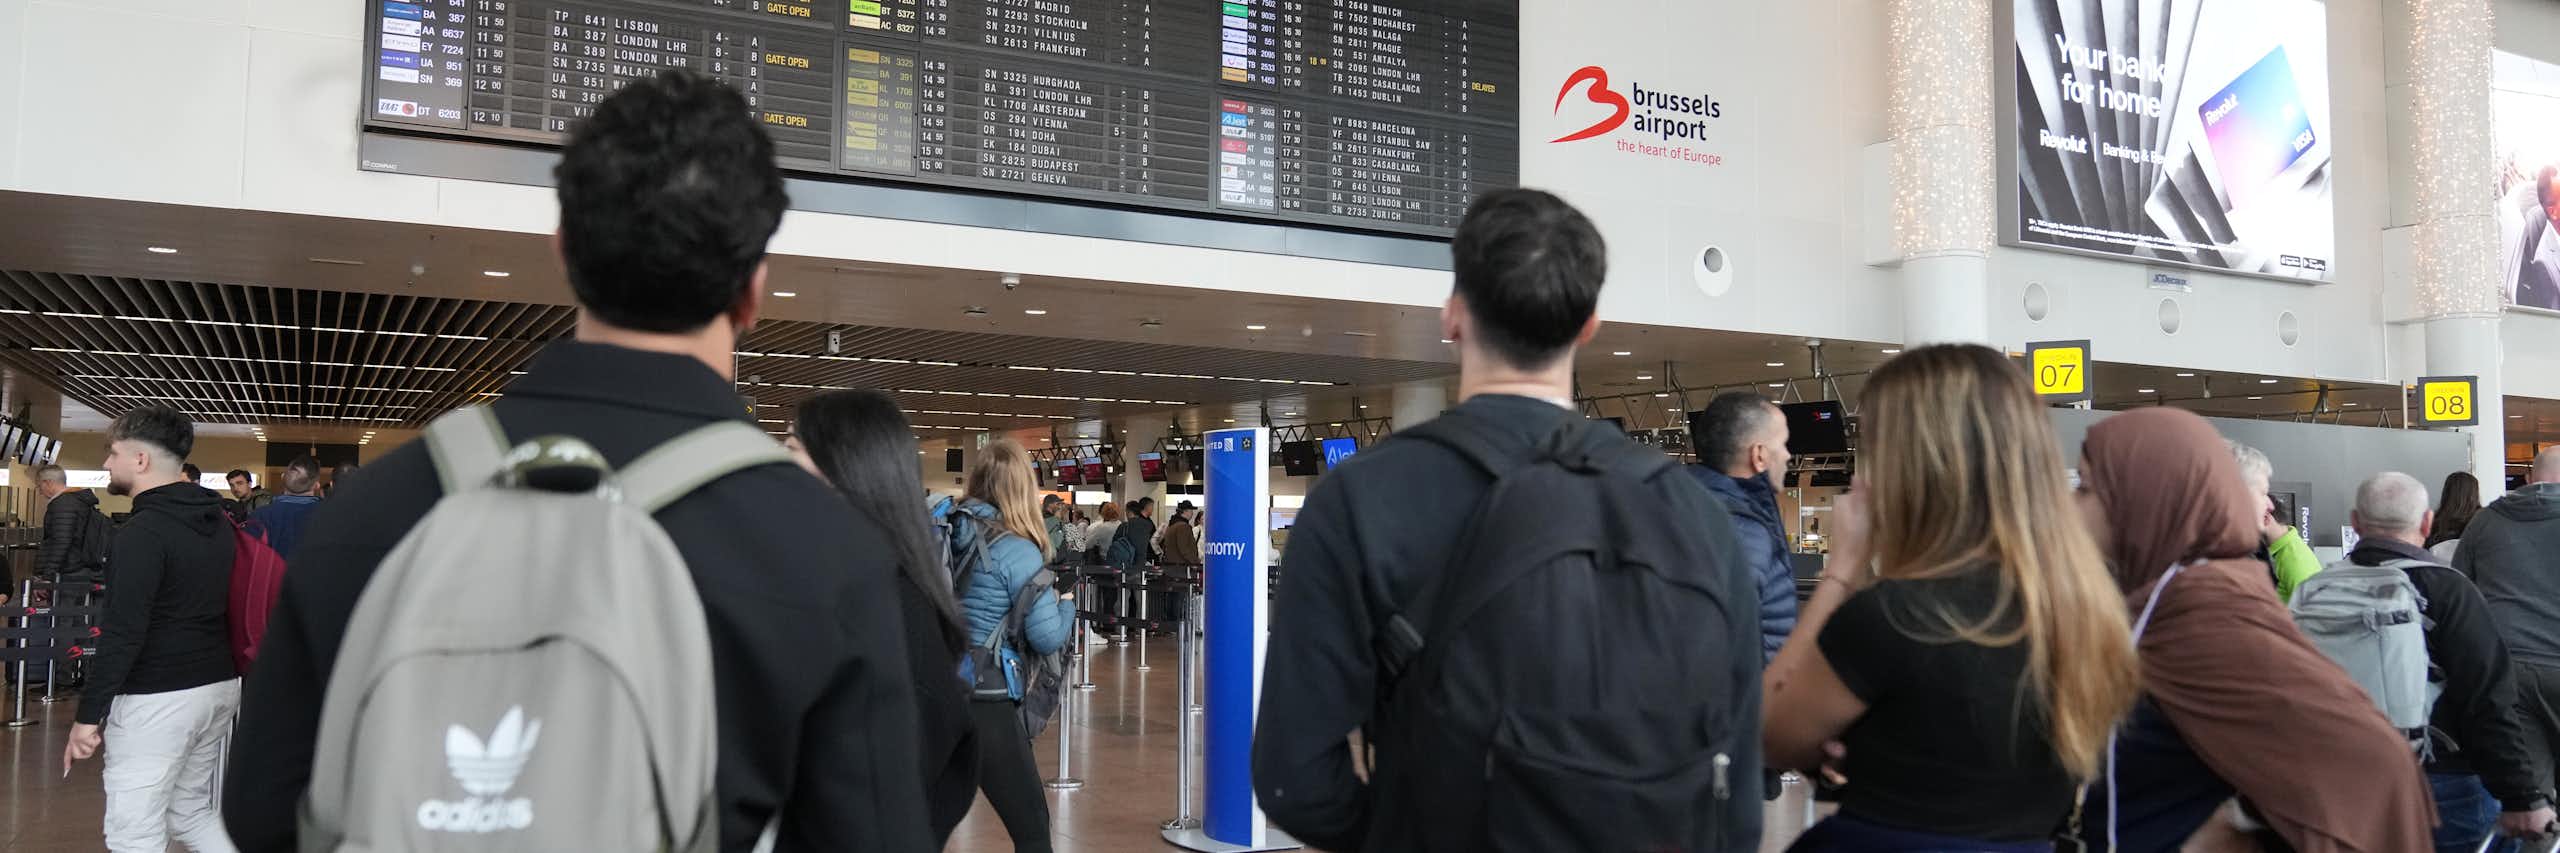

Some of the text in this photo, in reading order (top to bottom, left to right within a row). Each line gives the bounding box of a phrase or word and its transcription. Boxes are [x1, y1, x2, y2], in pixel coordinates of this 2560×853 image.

[423, 10, 435, 19] BA
[768, 3, 810, 18] GATE OPEN
[1034, 1, 1070, 14] MADRID
[1373, 6, 1402, 18] MUNICH
[479, 1, 658, 34] 11 50 TP 641 LISBON
[1034, 15, 1087, 30] STOCKHOLM
[1373, 17, 1416, 32] BUCHAREST
[422, 26, 464, 39] AA 6637
[1034, 28, 1075, 42] VILNIUS
[1373, 30, 1401, 41] MALAGA
[422, 42, 433, 51] EY
[478, 16, 808, 68] 11 50 BA 387 LONDON LHR GATE OPEN
[1034, 42, 1087, 57] FRANKFURT
[1373, 42, 1401, 54] PRAGUE
[478, 32, 686, 68] 11 50 BA 389 LONDON LHR
[421, 59, 433, 68] UA
[478, 48, 487, 57] 11
[494, 49, 503, 58] 50
[553, 58, 567, 68] SN
[576, 60, 605, 73] 3735
[1373, 54, 1406, 67] ANTALYA
[2055, 33, 2165, 83] Your bank
[477, 64, 486, 73] 11
[494, 65, 502, 74] 55
[553, 74, 567, 84] UA
[584, 77, 604, 88] 951
[1373, 67, 1401, 78] LONDON
[1407, 72, 1420, 81] LHR
[1033, 76, 1081, 91] HURGHADA
[1373, 79, 1420, 94] CASABLANCA
[1033, 90, 1069, 102] LONDON
[1075, 94, 1092, 105] LHR
[1372, 91, 1401, 103] DUBLIN
[1633, 82, 1720, 118] brussels
[2062, 73, 2160, 117] for home
[475, 80, 487, 89] 12
[492, 81, 502, 89] 00
[552, 89, 566, 99] SN
[764, 113, 783, 124] GATE
[786, 116, 807, 127] OPEN
[1033, 104, 1086, 119] AMSTERDAM
[474, 112, 564, 131] 12 10 IB
[1033, 118, 1068, 130] VIENNA
[1372, 122, 1415, 136] BARCELONA
[1634, 110, 1706, 141] airport
[1032, 131, 1056, 142] DOHA
[1373, 134, 1430, 150] ISTANBUL SAW
[2040, 129, 2087, 154] Revolut
[1032, 144, 1060, 156] DUBAI
[1372, 146, 1415, 160] FRANKFURT
[1617, 139, 1721, 166] the heart of Europe
[1032, 159, 1079, 172] BUDAPEST
[1372, 160, 1420, 174] CASABLANCA
[1032, 172, 1067, 185] GENEVA
[1372, 172, 1401, 183] VIENNA
[1372, 184, 1401, 196] LISBON
[1372, 197, 1401, 208] LONDON
[1407, 201, 1420, 210] LHR
[1372, 210, 1401, 222] ZURICH
[2041, 365, 2076, 387] 07
[2432, 396, 2464, 415] 08
[2302, 506, 2310, 545] Revol
[417, 797, 532, 832] adidas
